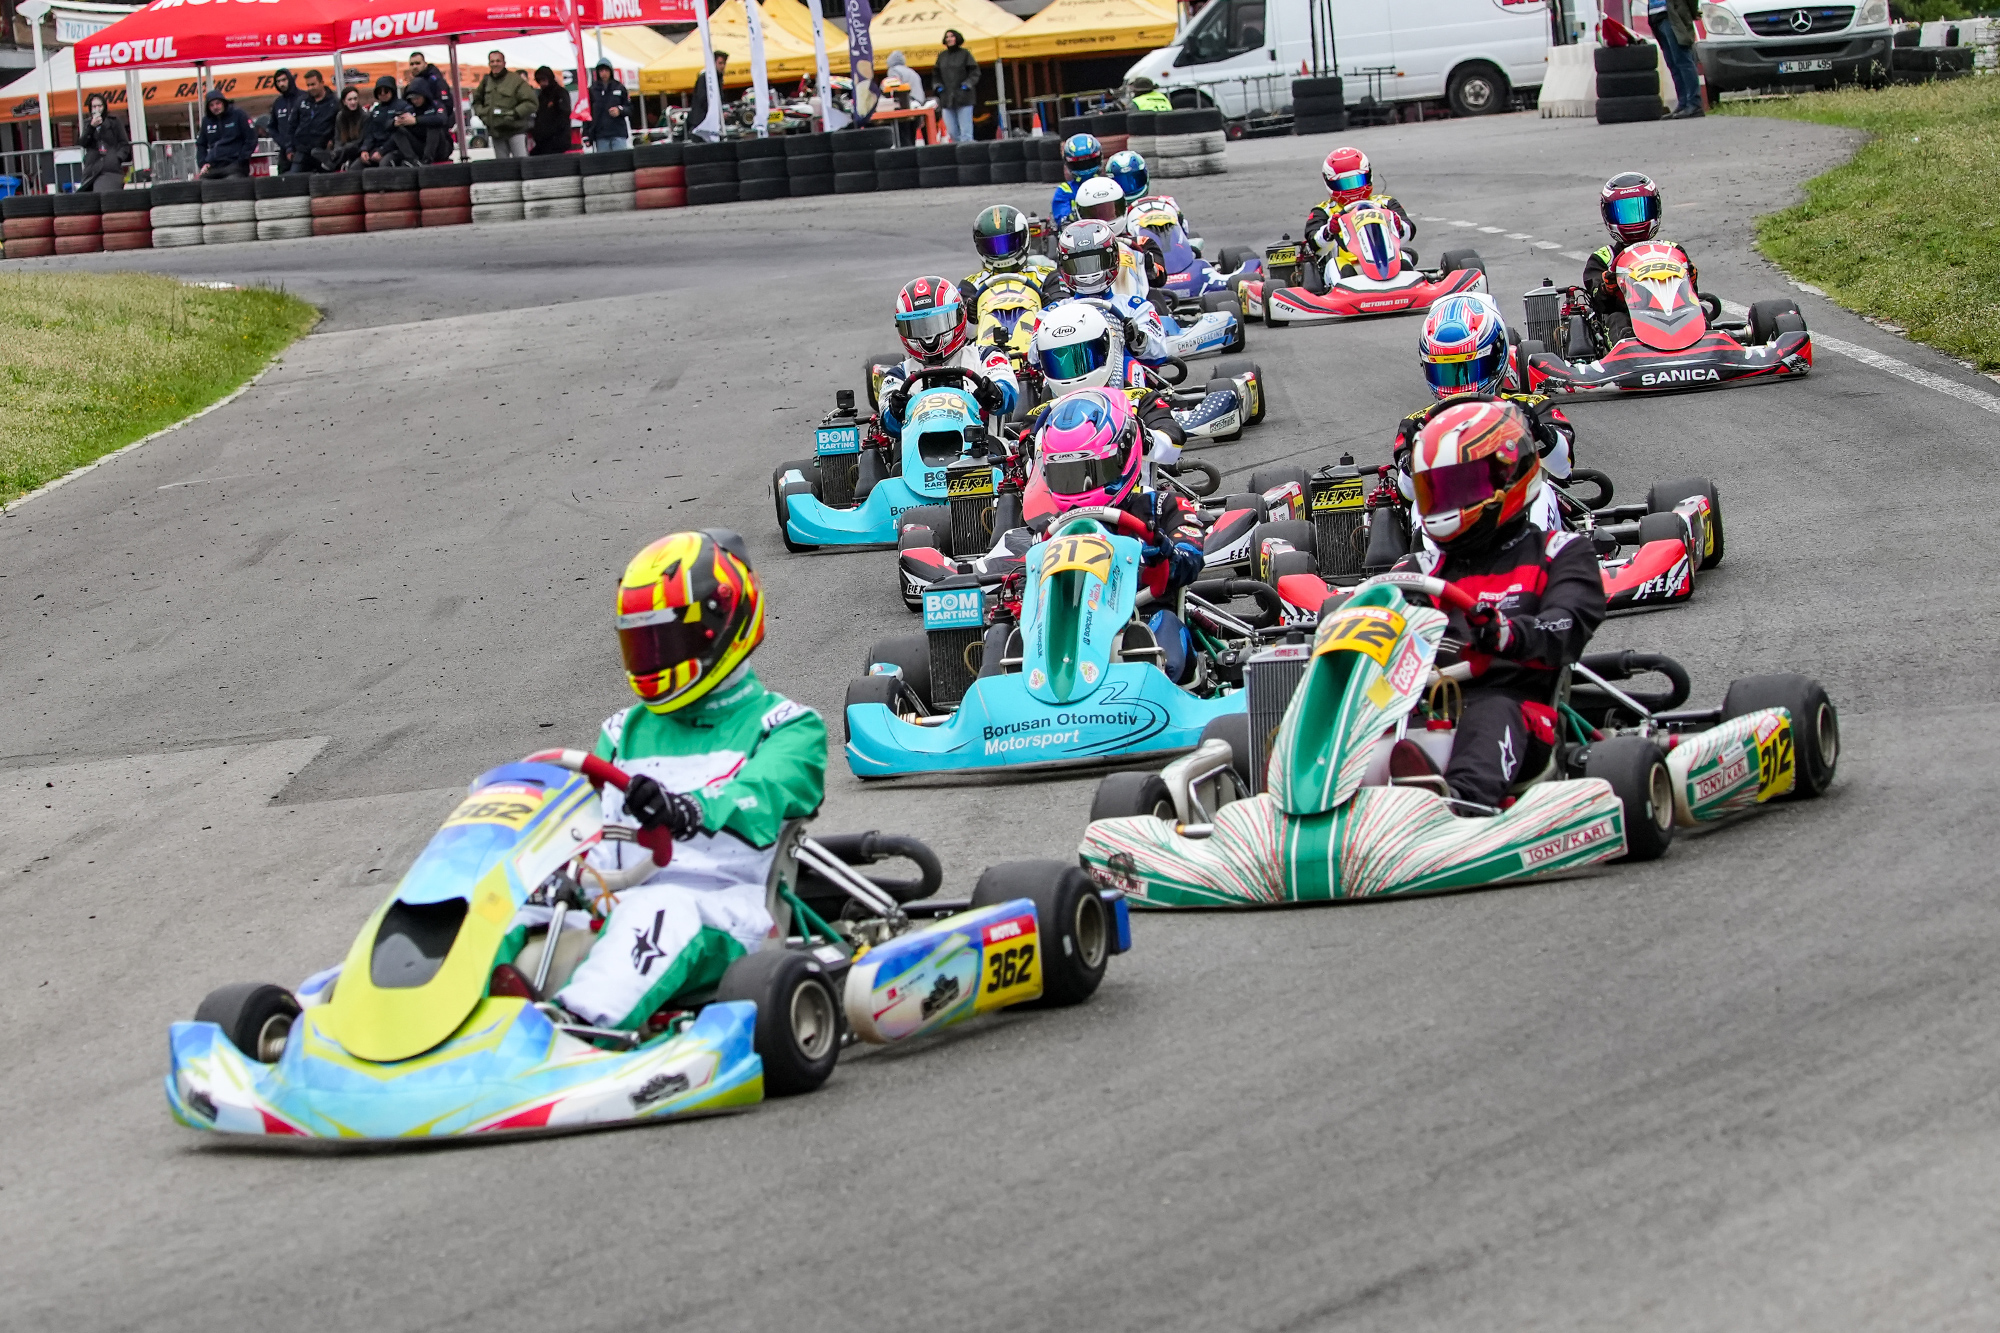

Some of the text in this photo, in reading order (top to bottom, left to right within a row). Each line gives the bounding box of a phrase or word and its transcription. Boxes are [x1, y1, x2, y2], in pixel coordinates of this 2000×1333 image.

[603, 0, 642, 20] MOTUL
[349, 9, 438, 43] MOTUL
[88, 37, 177, 67] MOTUL
[1637, 262, 1683, 279] 399
[1641, 367, 1721, 386] SANICA
[818, 430, 855, 443] BOM
[1040, 538, 1112, 581] 317
[926, 592, 978, 612] BOM
[1392, 652, 1419, 691] tesa
[982, 711, 1139, 741] Borusan Otomotiv
[984, 729, 1080, 756] Motorsport
[1759, 727, 1792, 788] 312
[1695, 770, 1723, 800] TONY
[1724, 755, 1749, 788] KART
[1525, 821, 1614, 866] TONY KART
[989, 921, 1022, 942] MOTUL
[987, 944, 1035, 993] 362
